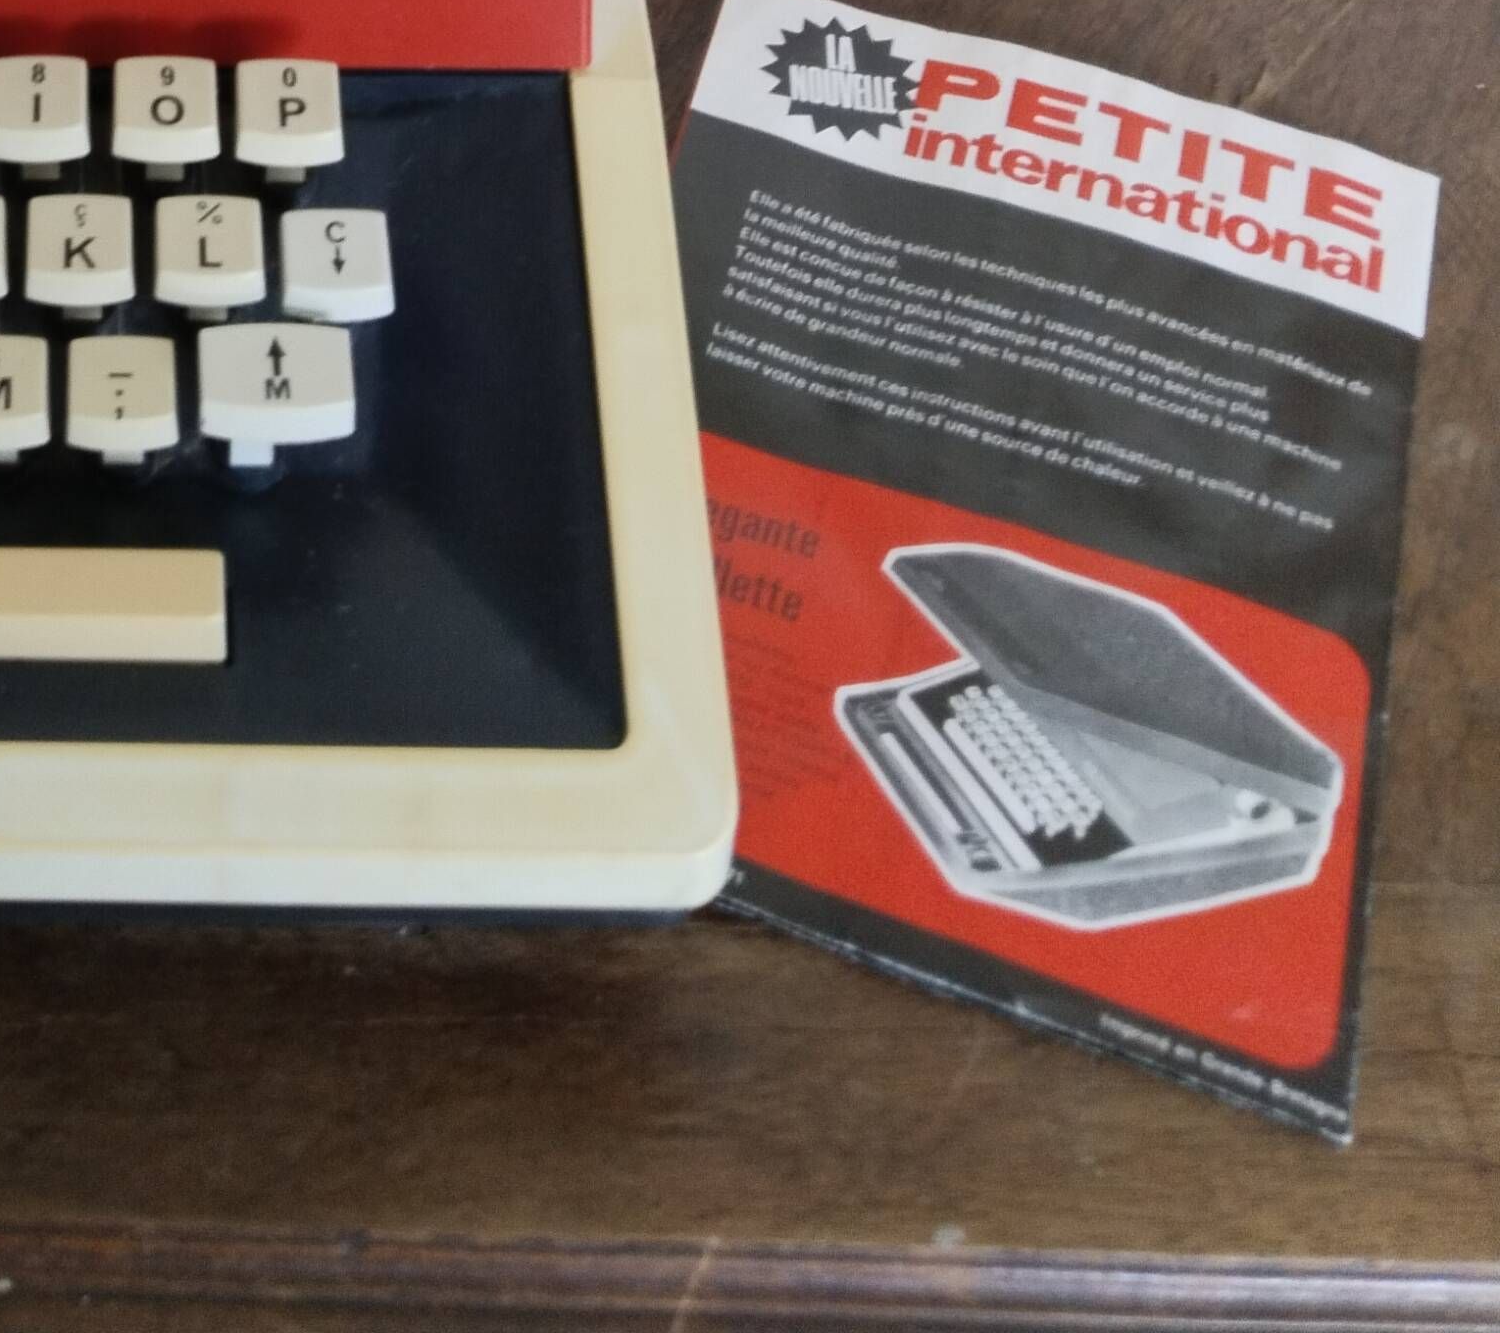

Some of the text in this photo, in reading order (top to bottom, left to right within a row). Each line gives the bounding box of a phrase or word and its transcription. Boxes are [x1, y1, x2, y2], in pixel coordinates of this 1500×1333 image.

[825, 33, 857, 73] LA
[31, 63, 46, 84] 8
[160, 66, 175, 86] 9
[788, 64, 898, 114] NOUVELLE
[150, 95, 185, 126] O
[278, 97, 306, 128] P
[915, 59, 1384, 241] PETITE
[903, 113, 1384, 294] international
[324, 221, 345, 244] C
[64, 237, 95, 269] K
[198, 236, 222, 268] L
[265, 378, 290, 399] M
